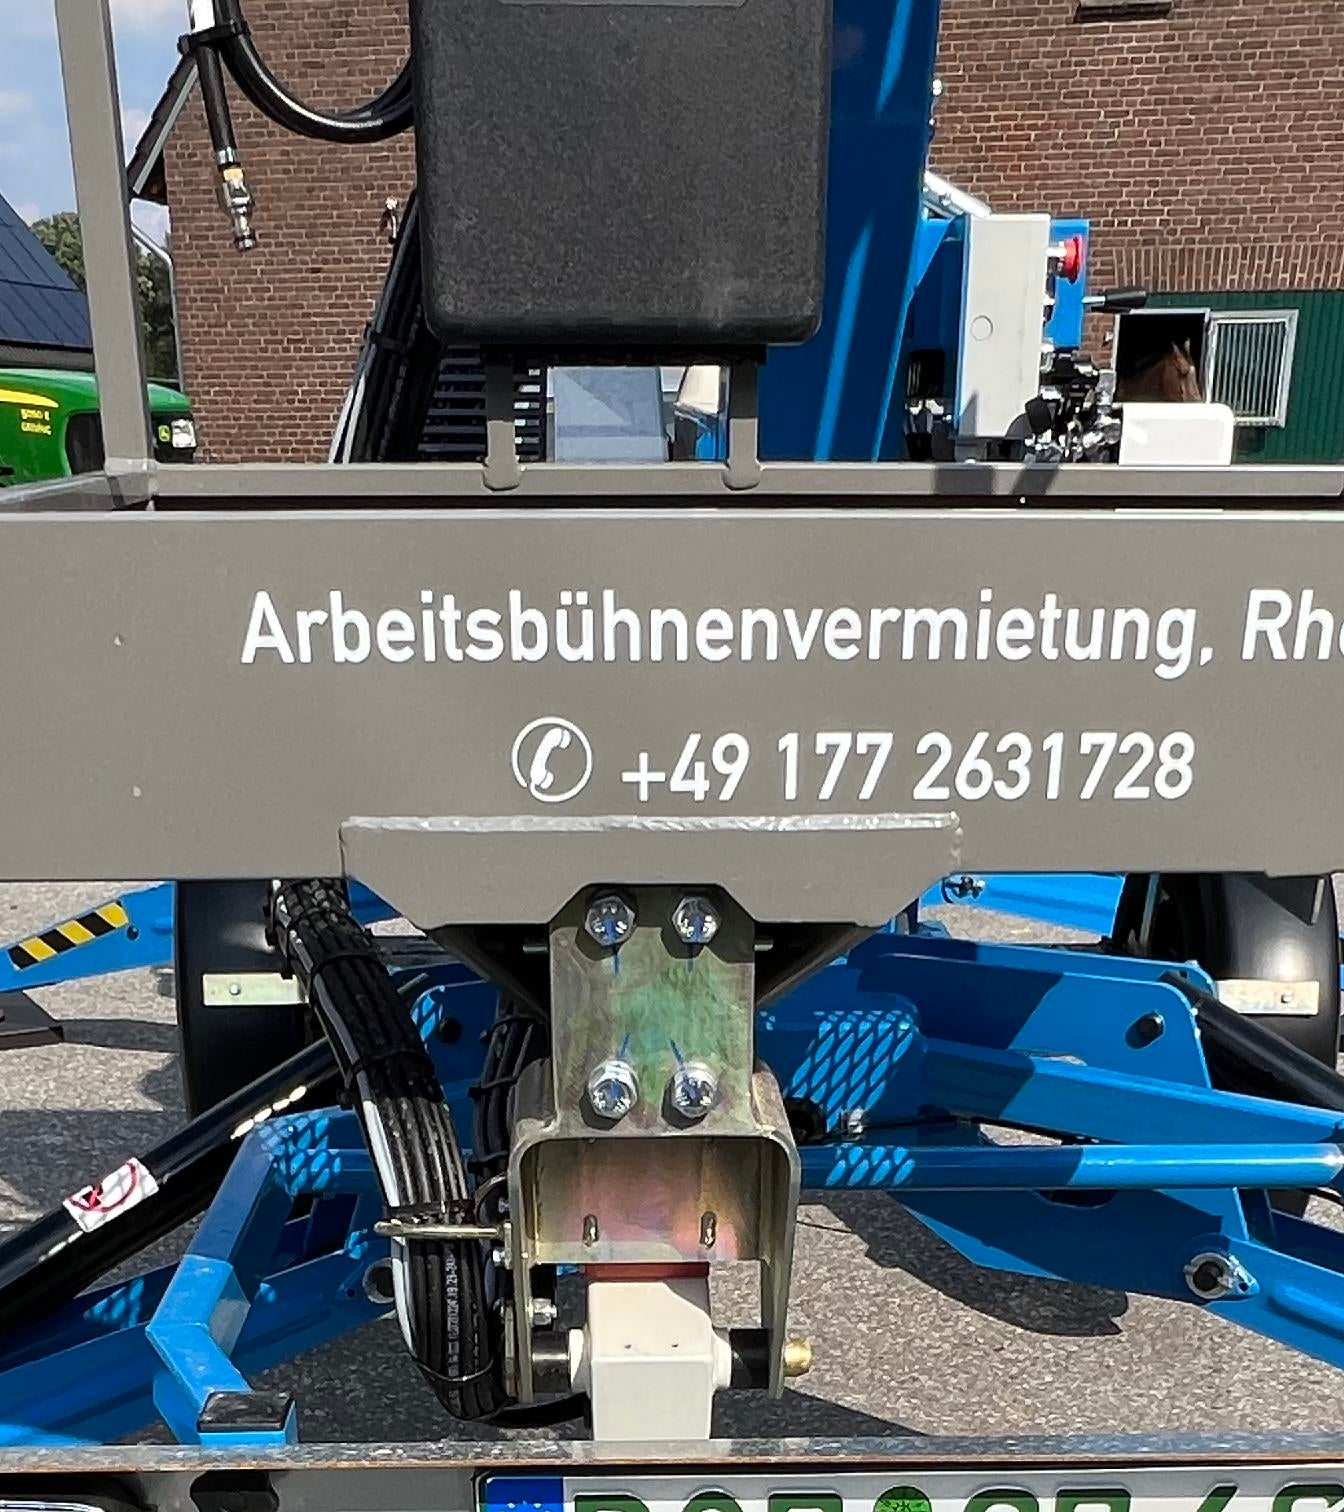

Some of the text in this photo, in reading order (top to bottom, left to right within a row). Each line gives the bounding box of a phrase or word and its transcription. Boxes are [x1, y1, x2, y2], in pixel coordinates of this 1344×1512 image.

[241, 588, 1214, 679] Arbeitsbühnenvermietung,
[622, 731, 1195, 802] +49 177 2631728
